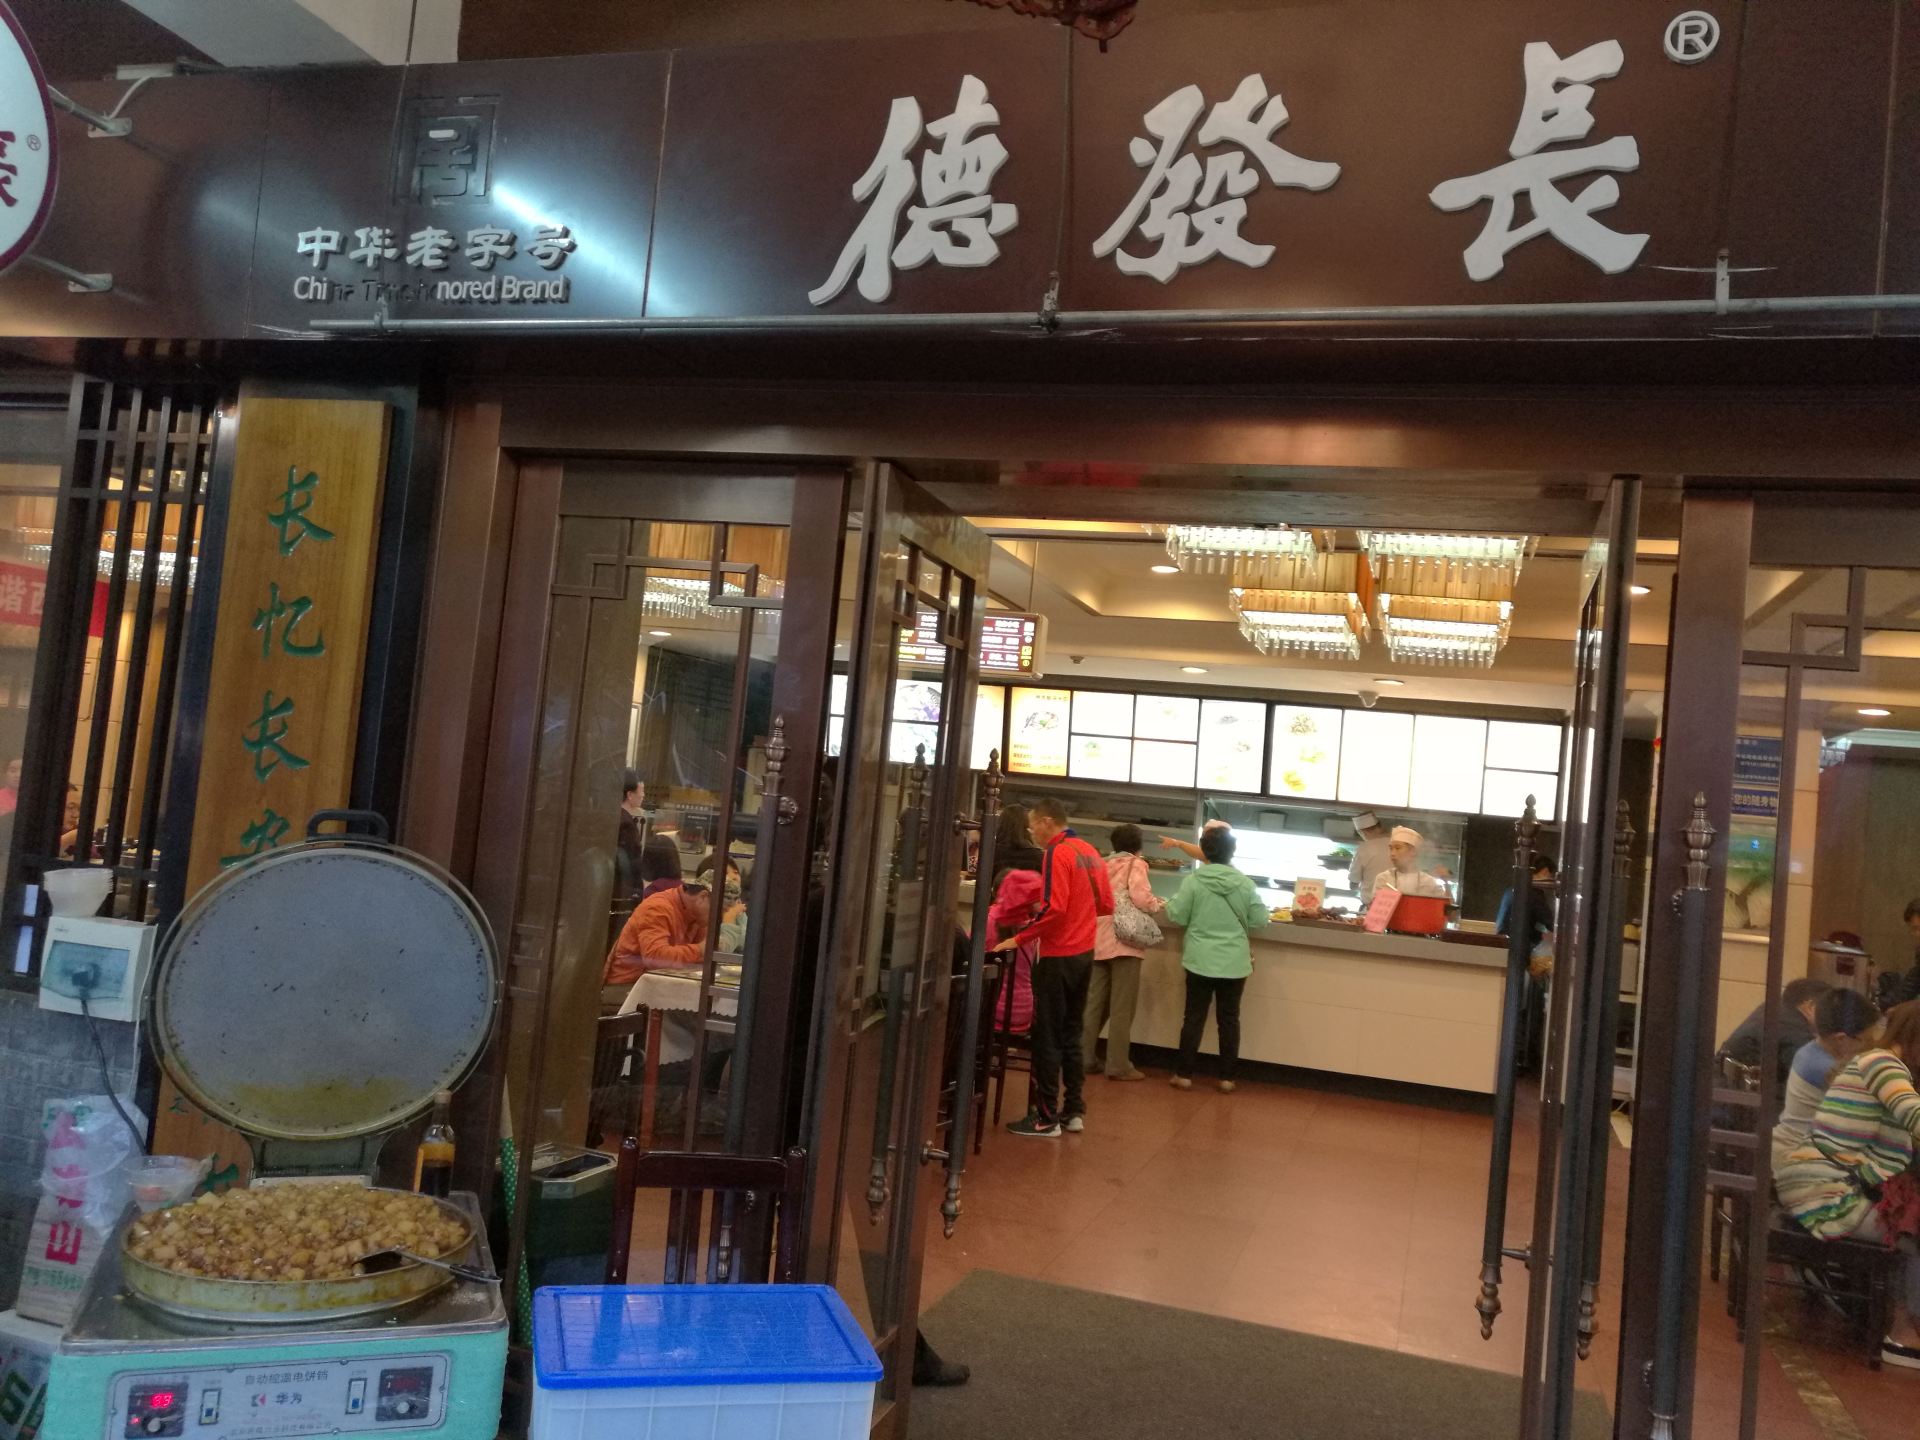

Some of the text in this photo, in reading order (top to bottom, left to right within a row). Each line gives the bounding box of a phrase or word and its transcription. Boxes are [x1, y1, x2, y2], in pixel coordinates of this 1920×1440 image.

[297, 225, 576, 269] 中华老字号
[501, 275, 565, 301] Brand
